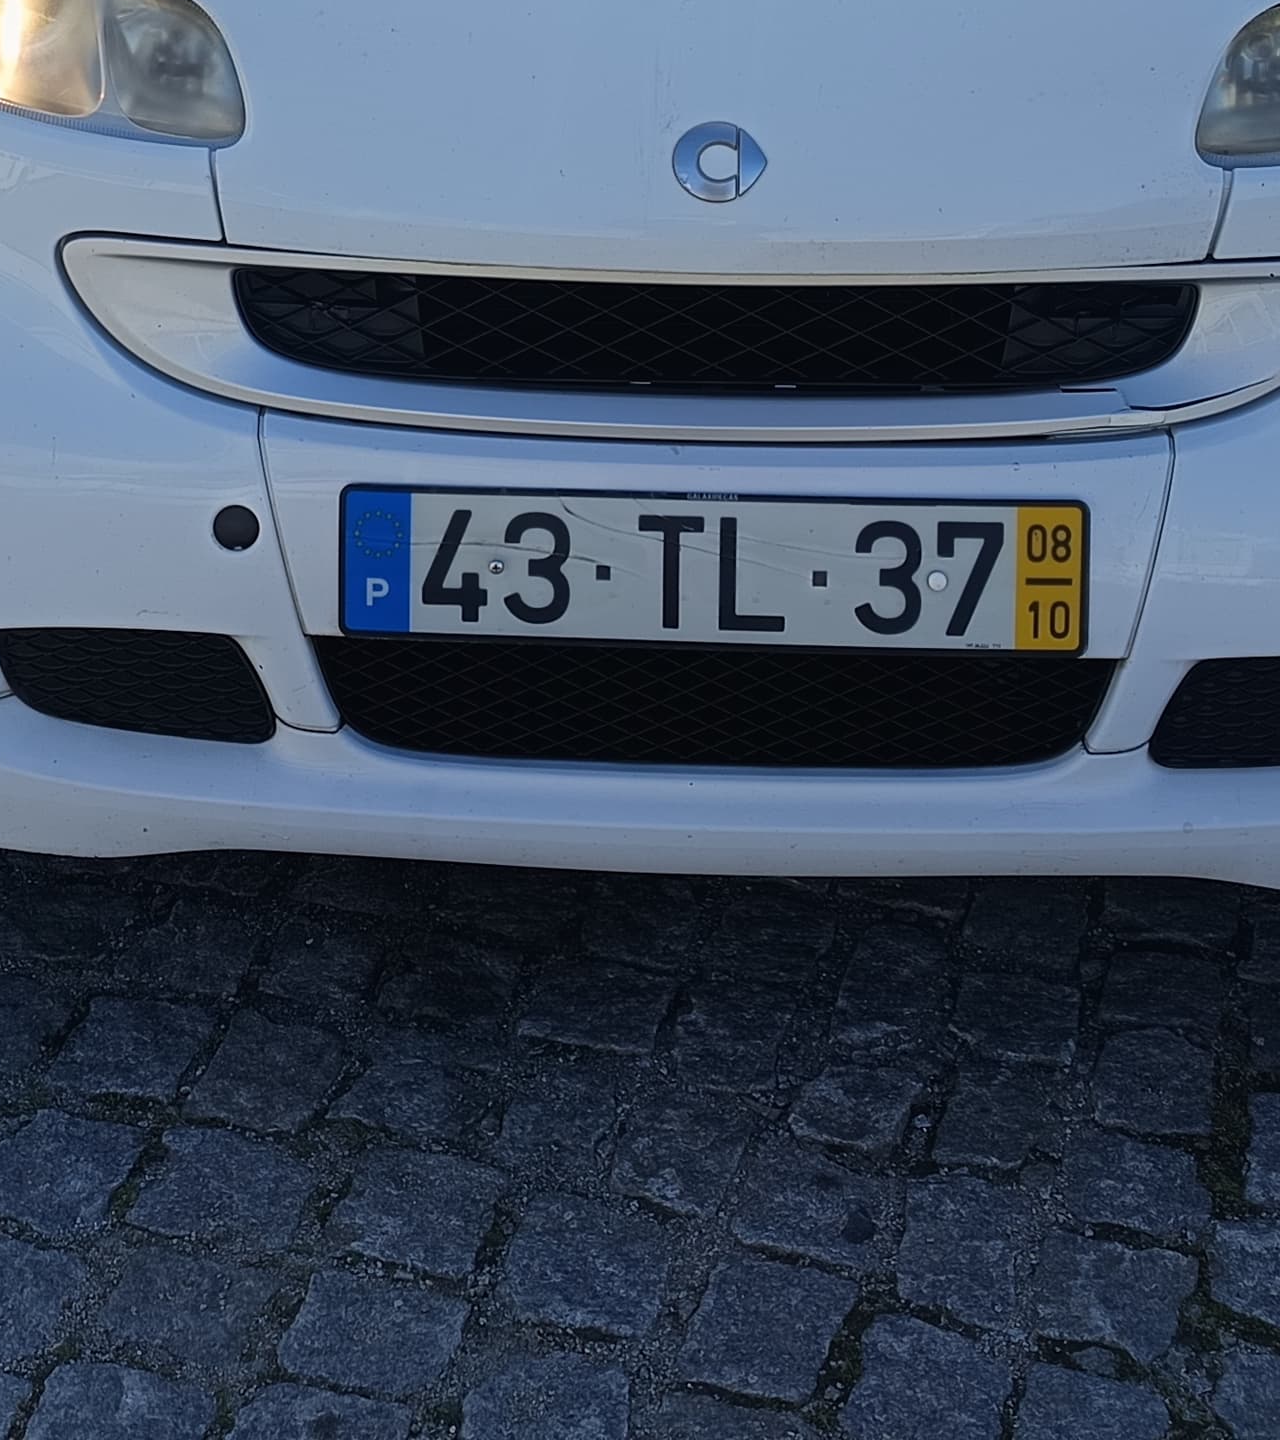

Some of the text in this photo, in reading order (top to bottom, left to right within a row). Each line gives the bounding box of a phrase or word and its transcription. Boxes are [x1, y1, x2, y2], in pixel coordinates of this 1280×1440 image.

[1026, 524, 1072, 563] 08
[366, 577, 390, 607] P
[1028, 600, 1071, 639] 10
